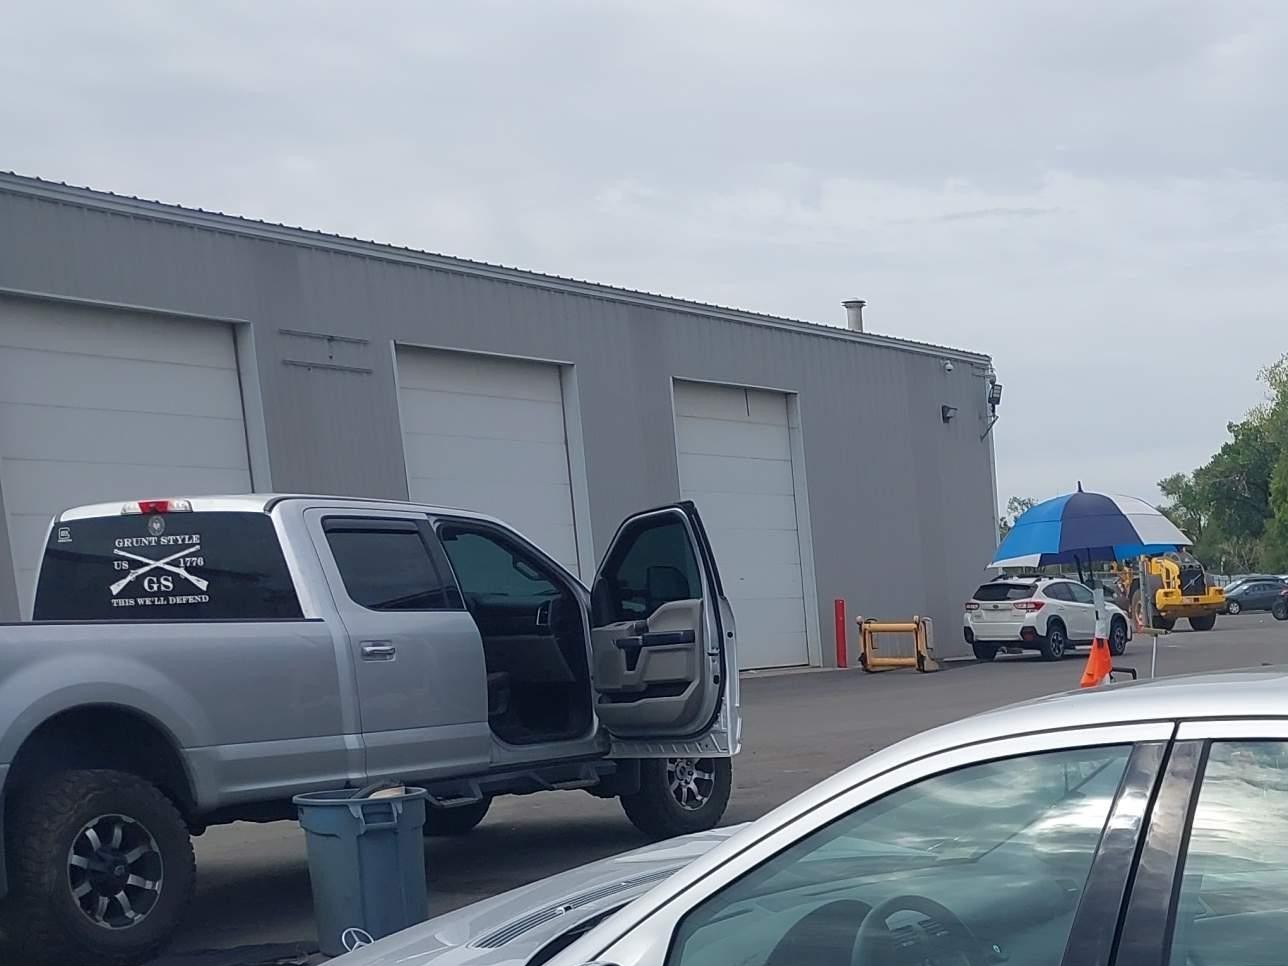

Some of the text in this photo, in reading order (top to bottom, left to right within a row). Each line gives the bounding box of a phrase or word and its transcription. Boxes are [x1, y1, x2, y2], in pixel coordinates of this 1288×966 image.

[115, 534, 200, 548] GRUNT STYLE
[113, 557, 204, 570] US 1776
[143, 575, 174, 592] GS
[111, 594, 209, 607] THIS WE'LL DEFEND
